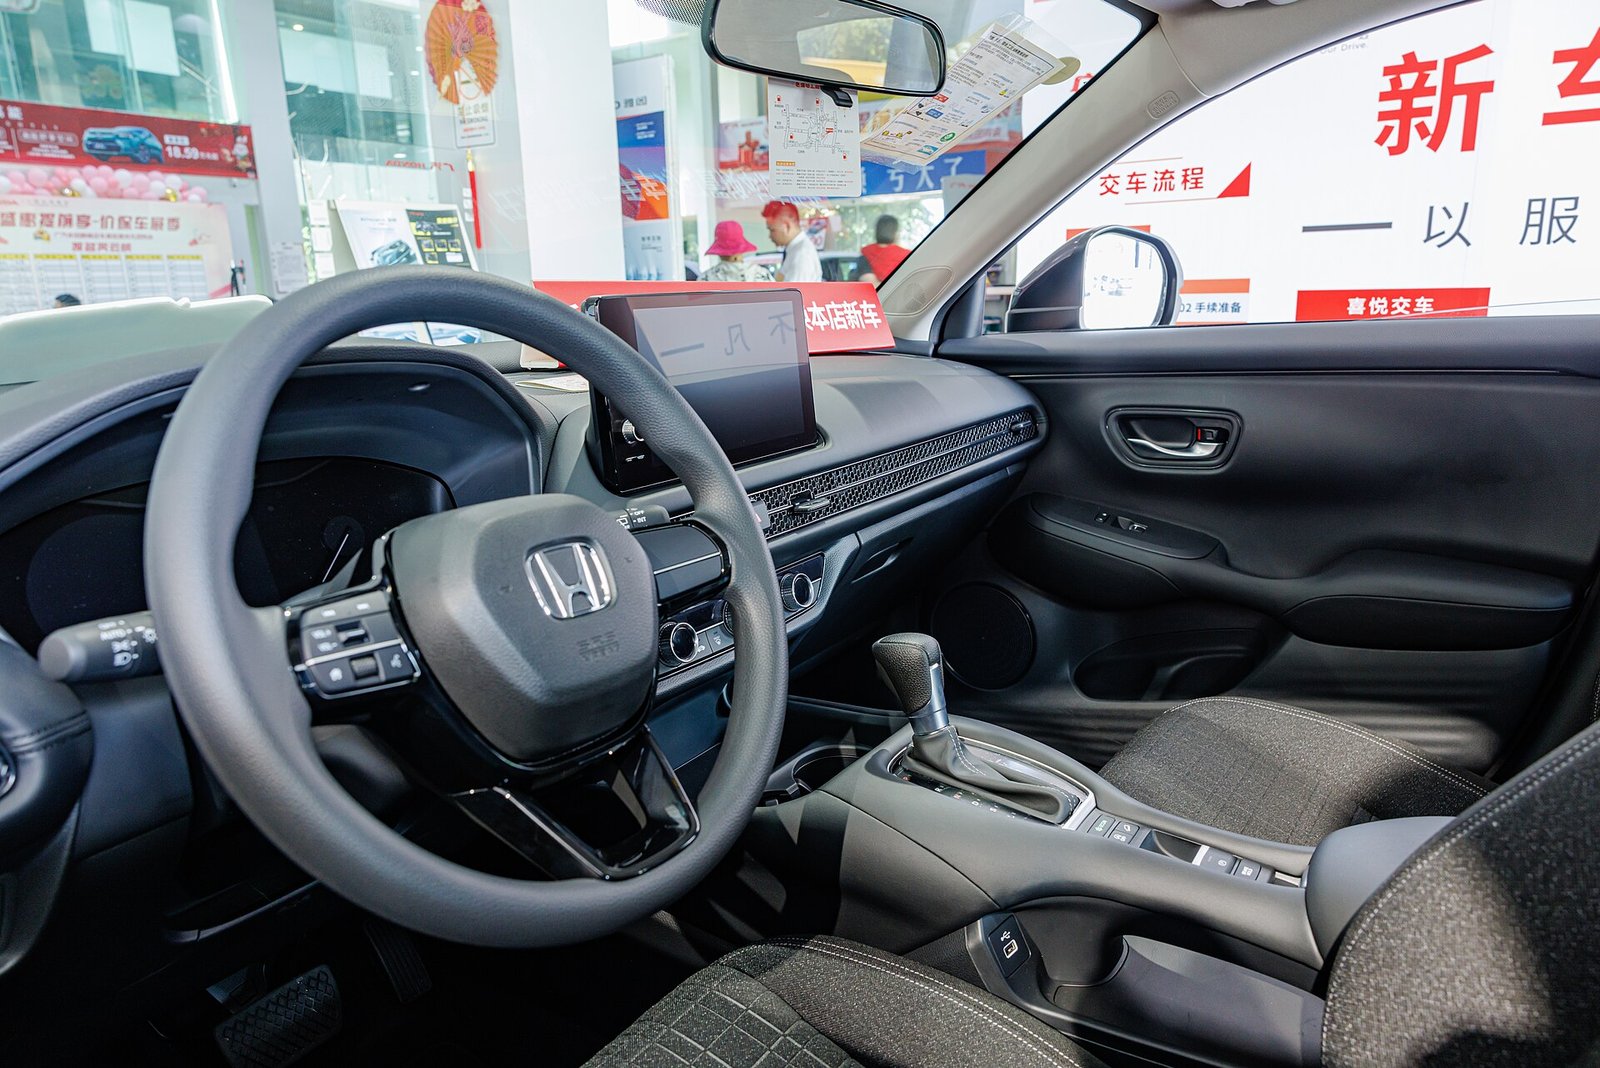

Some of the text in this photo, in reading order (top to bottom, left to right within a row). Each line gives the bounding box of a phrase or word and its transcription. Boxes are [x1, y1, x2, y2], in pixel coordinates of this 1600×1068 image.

[1099, 166, 1205, 196] 交车流程
[1195, 302, 1242, 313] 手续准备
[1346, 296, 1435, 316] 喜悦交车
